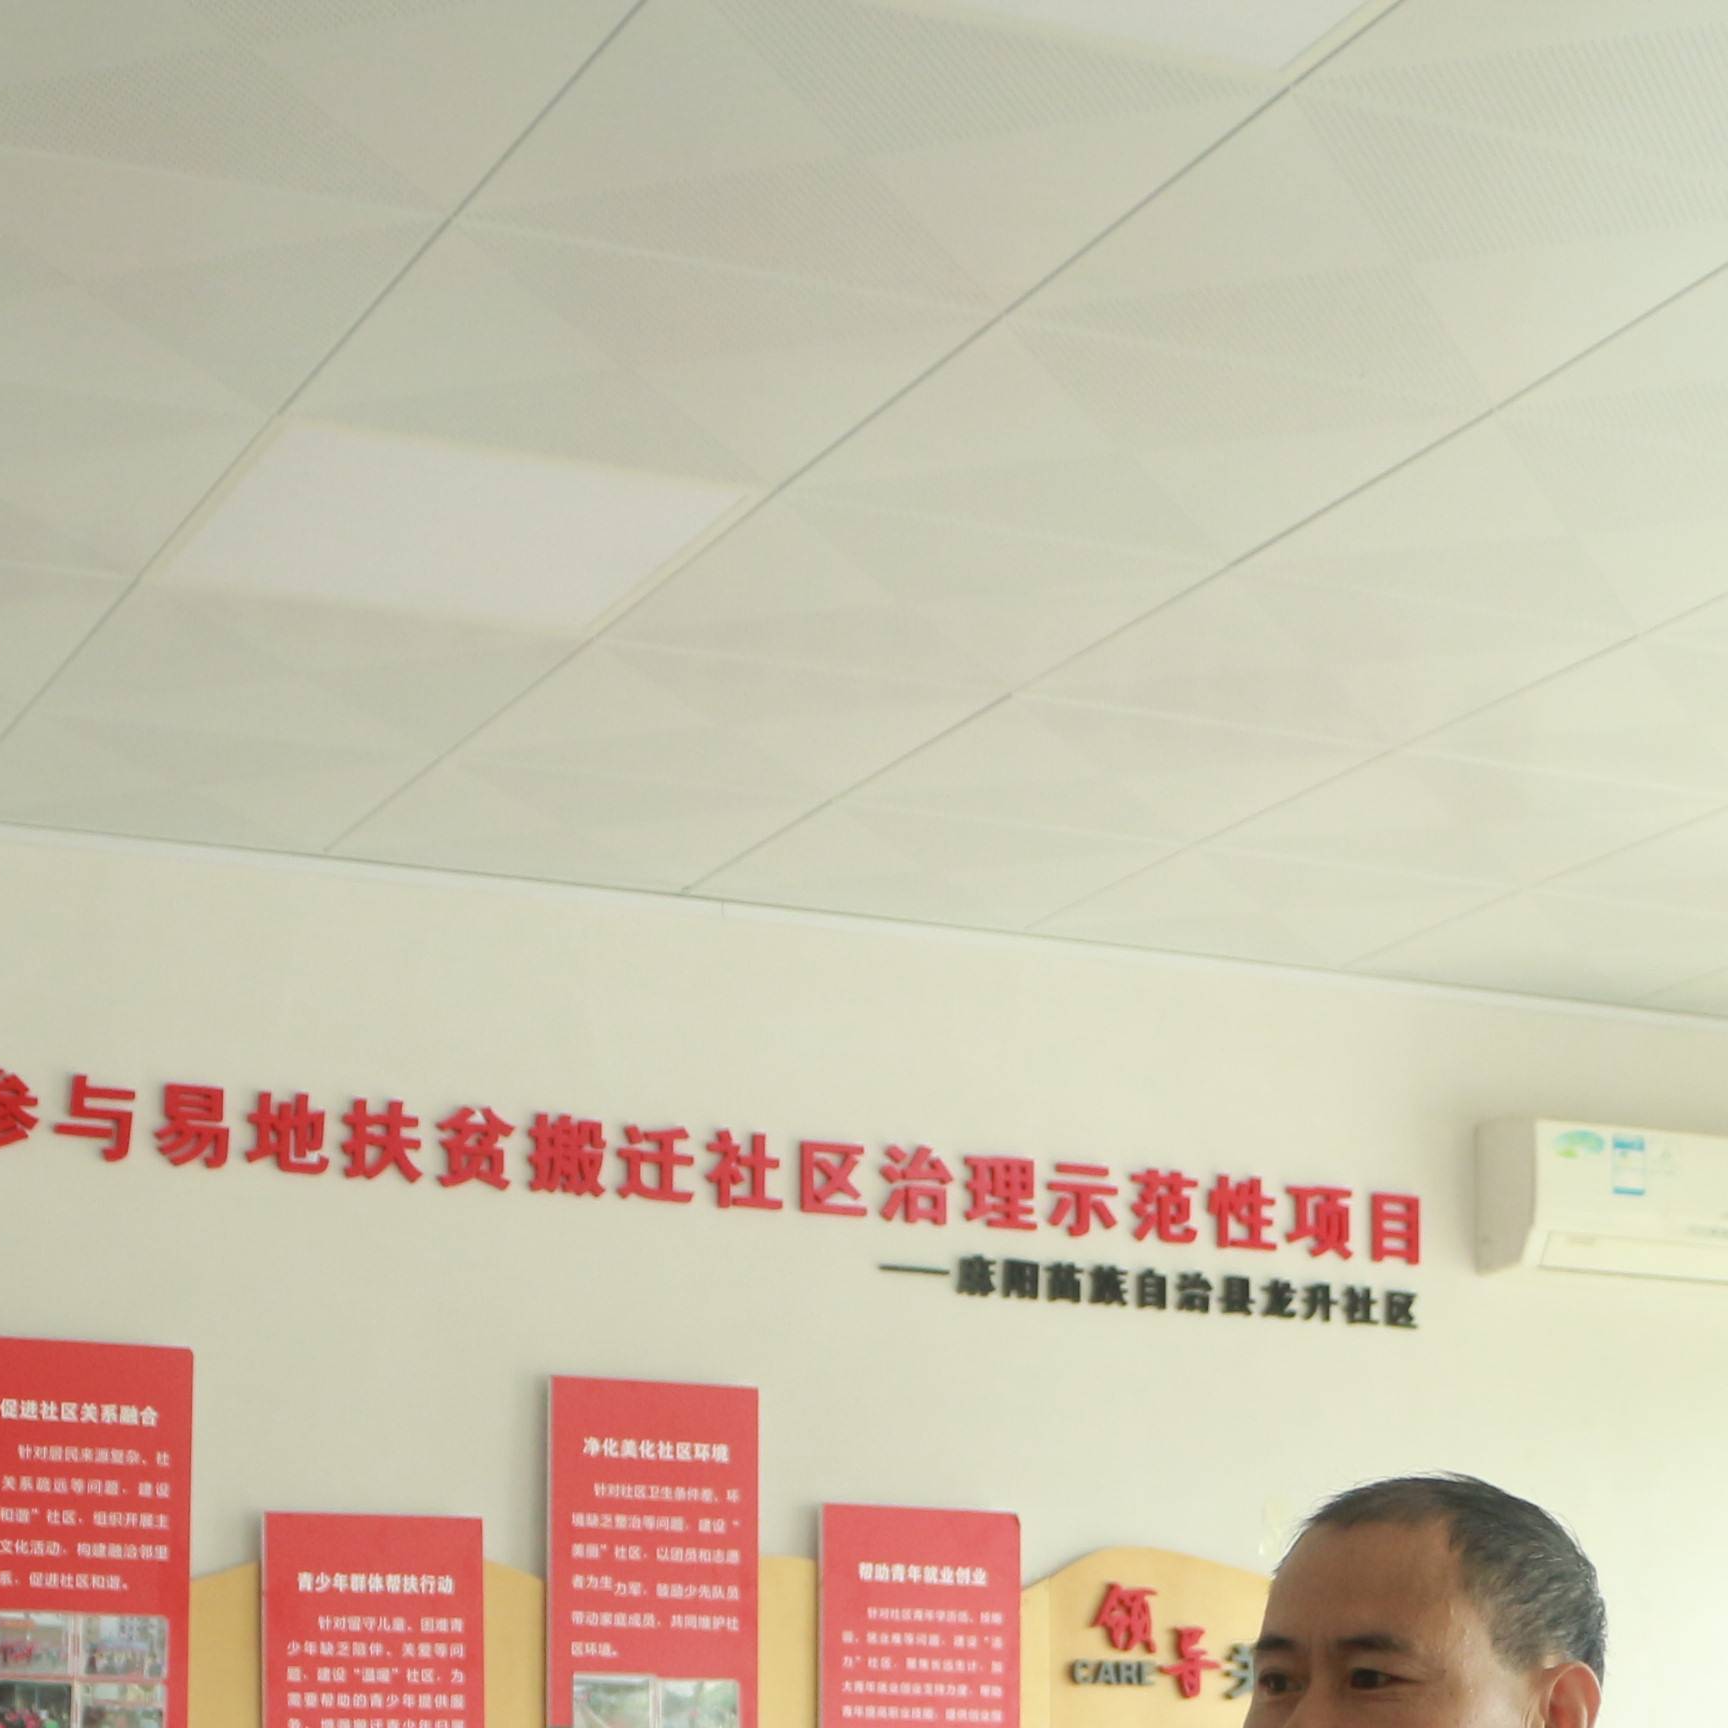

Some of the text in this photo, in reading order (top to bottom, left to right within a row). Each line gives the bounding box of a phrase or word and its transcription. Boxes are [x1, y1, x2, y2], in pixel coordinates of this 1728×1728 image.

[0, 1398, 159, 1427] 促进社区关系融合
[582, 1436, 731, 1464] 净化美化社区环境
[297, 1571, 455, 1595] 青少年群体帮扶行动
[858, 1562, 989, 1586] 帮助青年就业创业
[1072, 1659, 1157, 1686] CARE
